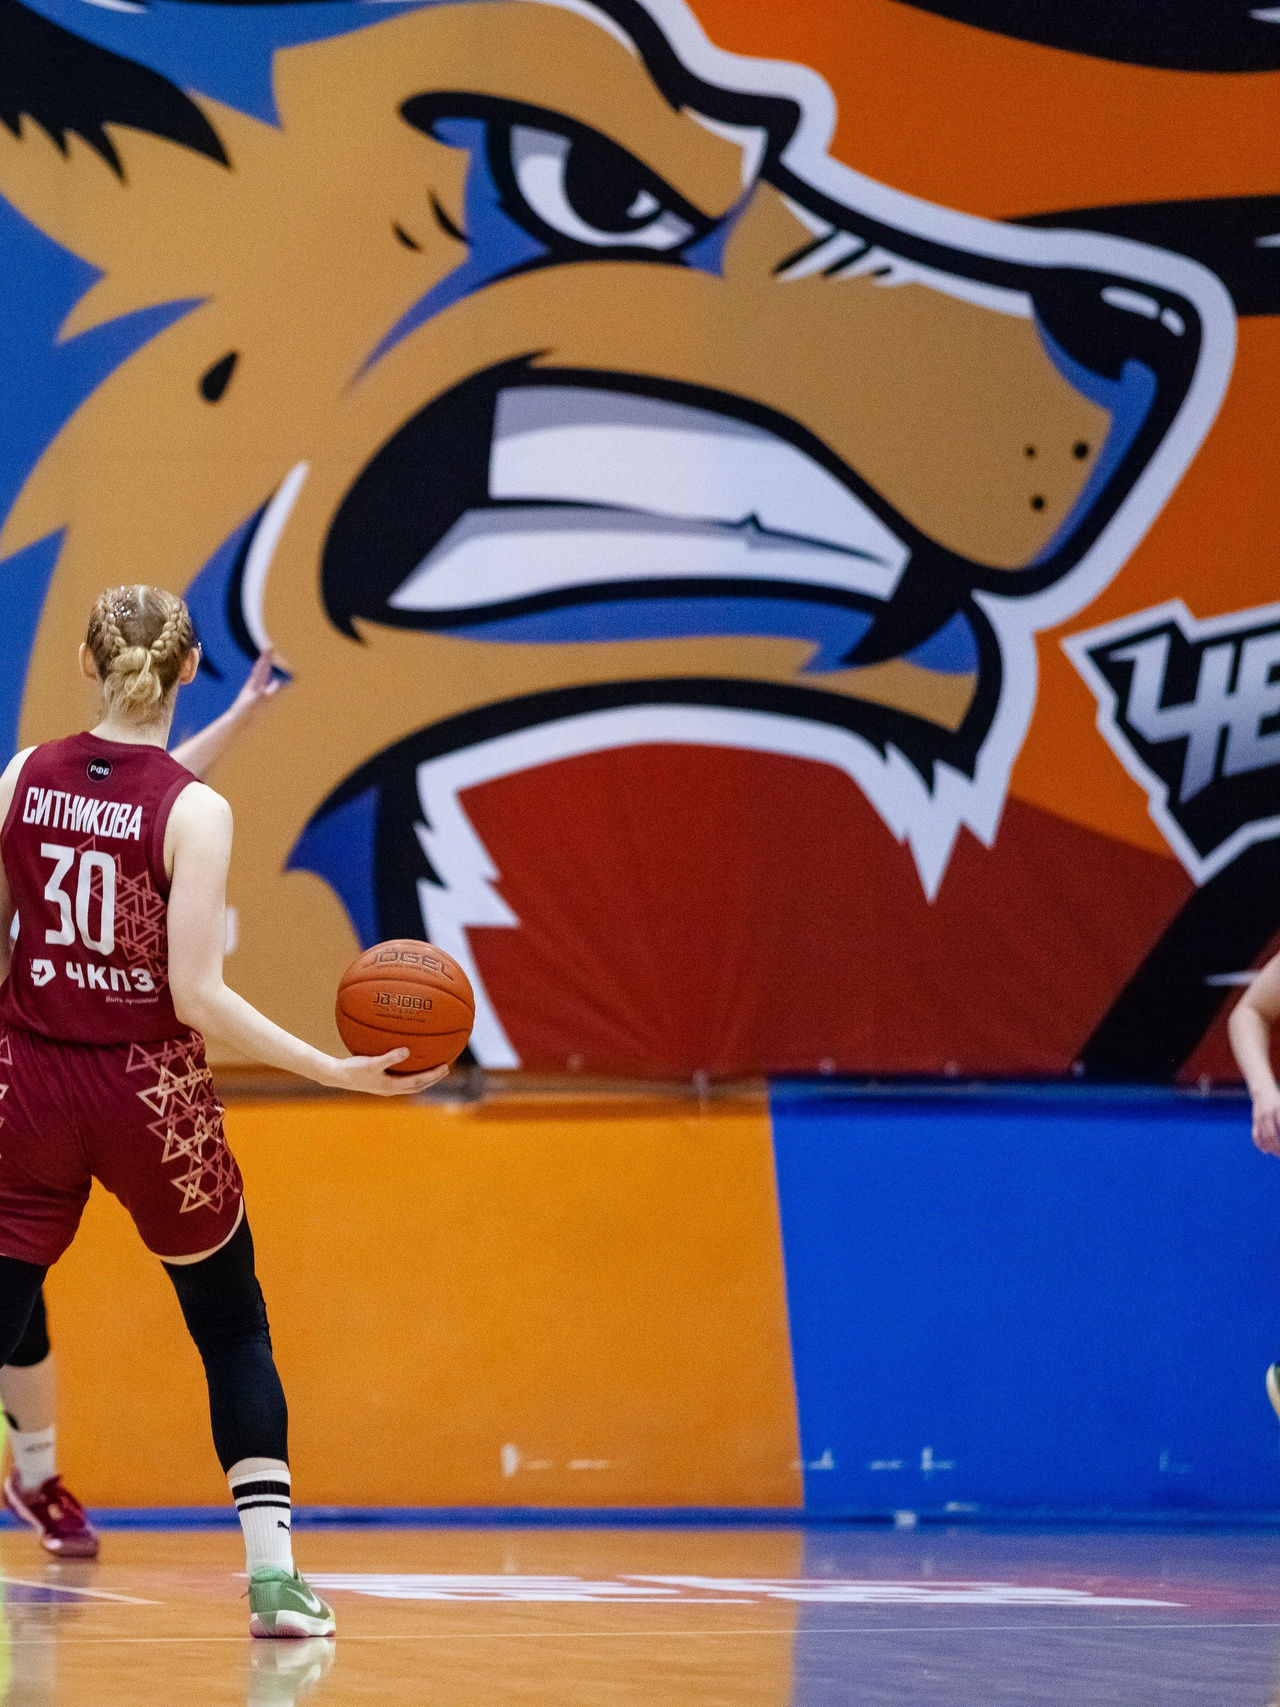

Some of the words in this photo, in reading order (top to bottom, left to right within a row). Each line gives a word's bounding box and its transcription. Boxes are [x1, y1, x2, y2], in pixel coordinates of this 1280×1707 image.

[90, 764, 110, 776] РФБ
[22, 786, 143, 841] СИТНИКОВА
[40, 842, 116, 956] 30
[65, 961, 155, 992] ЧКПЗ
[371, 992, 433, 1011] JB-1000
